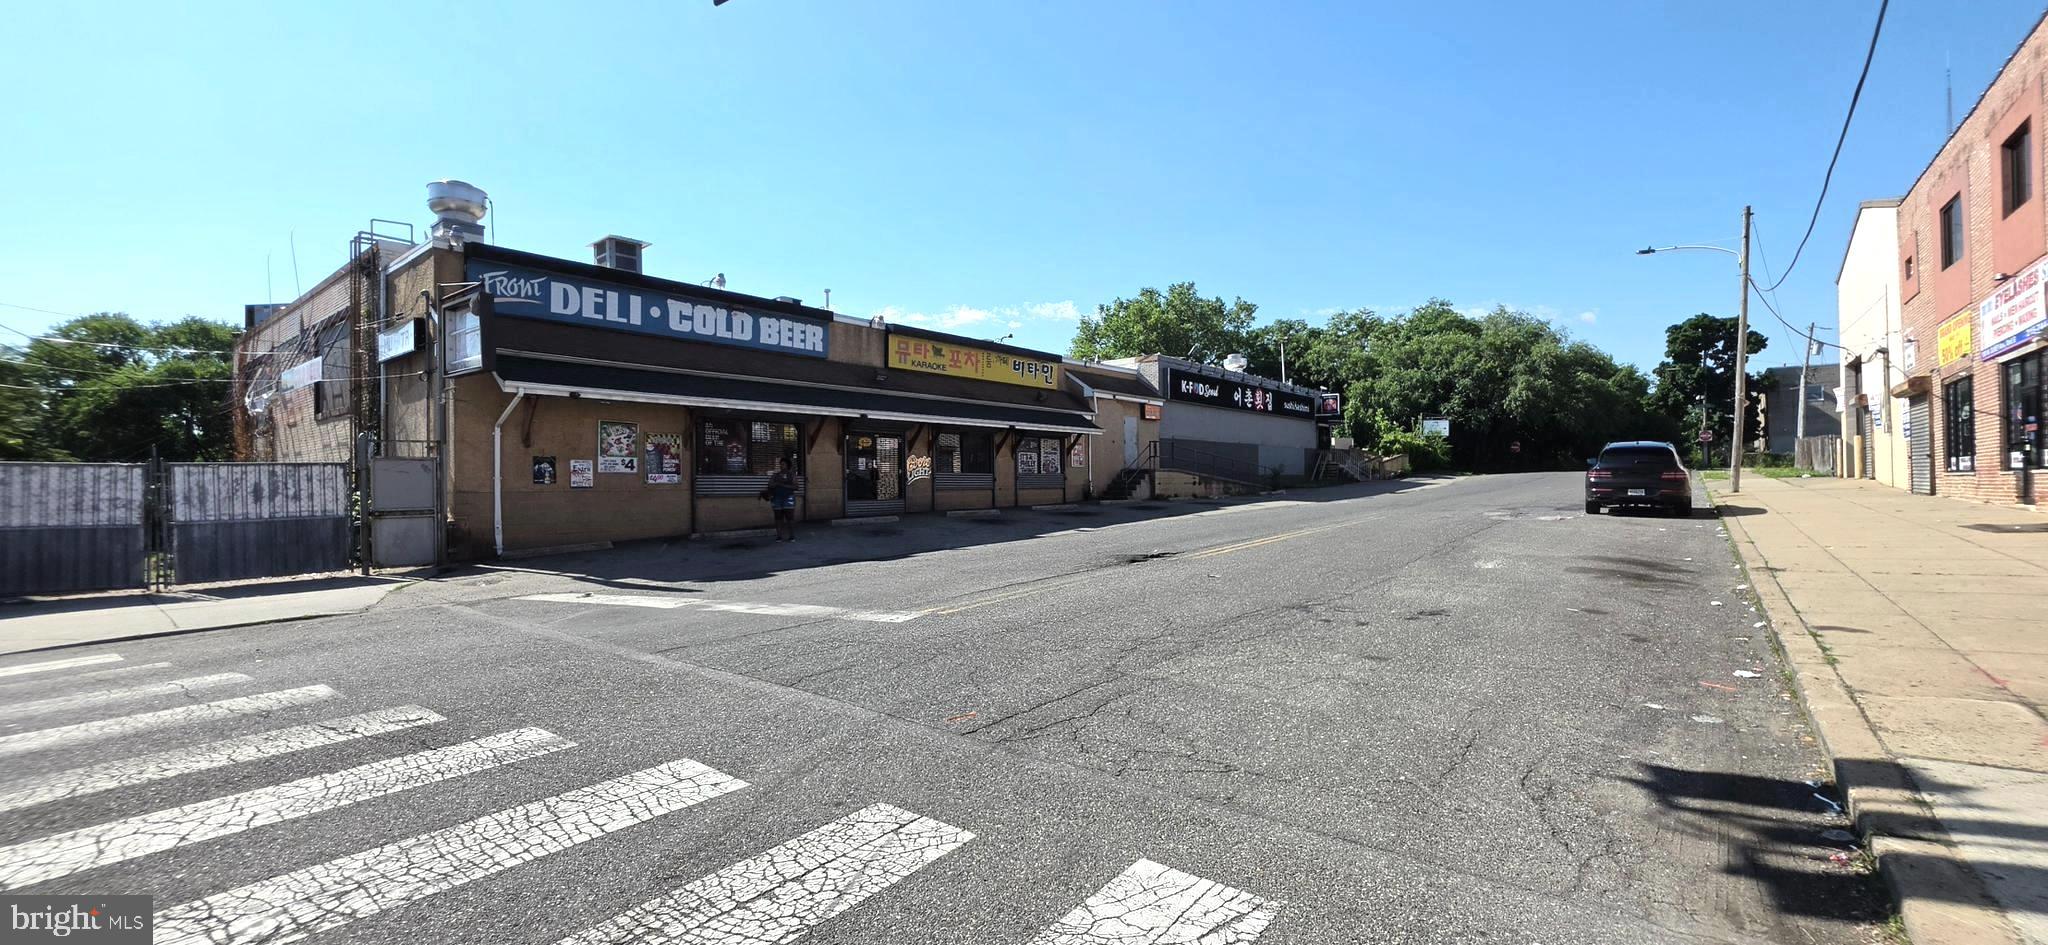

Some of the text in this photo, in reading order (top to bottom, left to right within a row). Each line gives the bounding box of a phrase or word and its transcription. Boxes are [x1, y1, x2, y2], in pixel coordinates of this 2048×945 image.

[550, 281, 823, 352] DELI COLD BEER
[912, 360, 947, 371] KARAOKE
